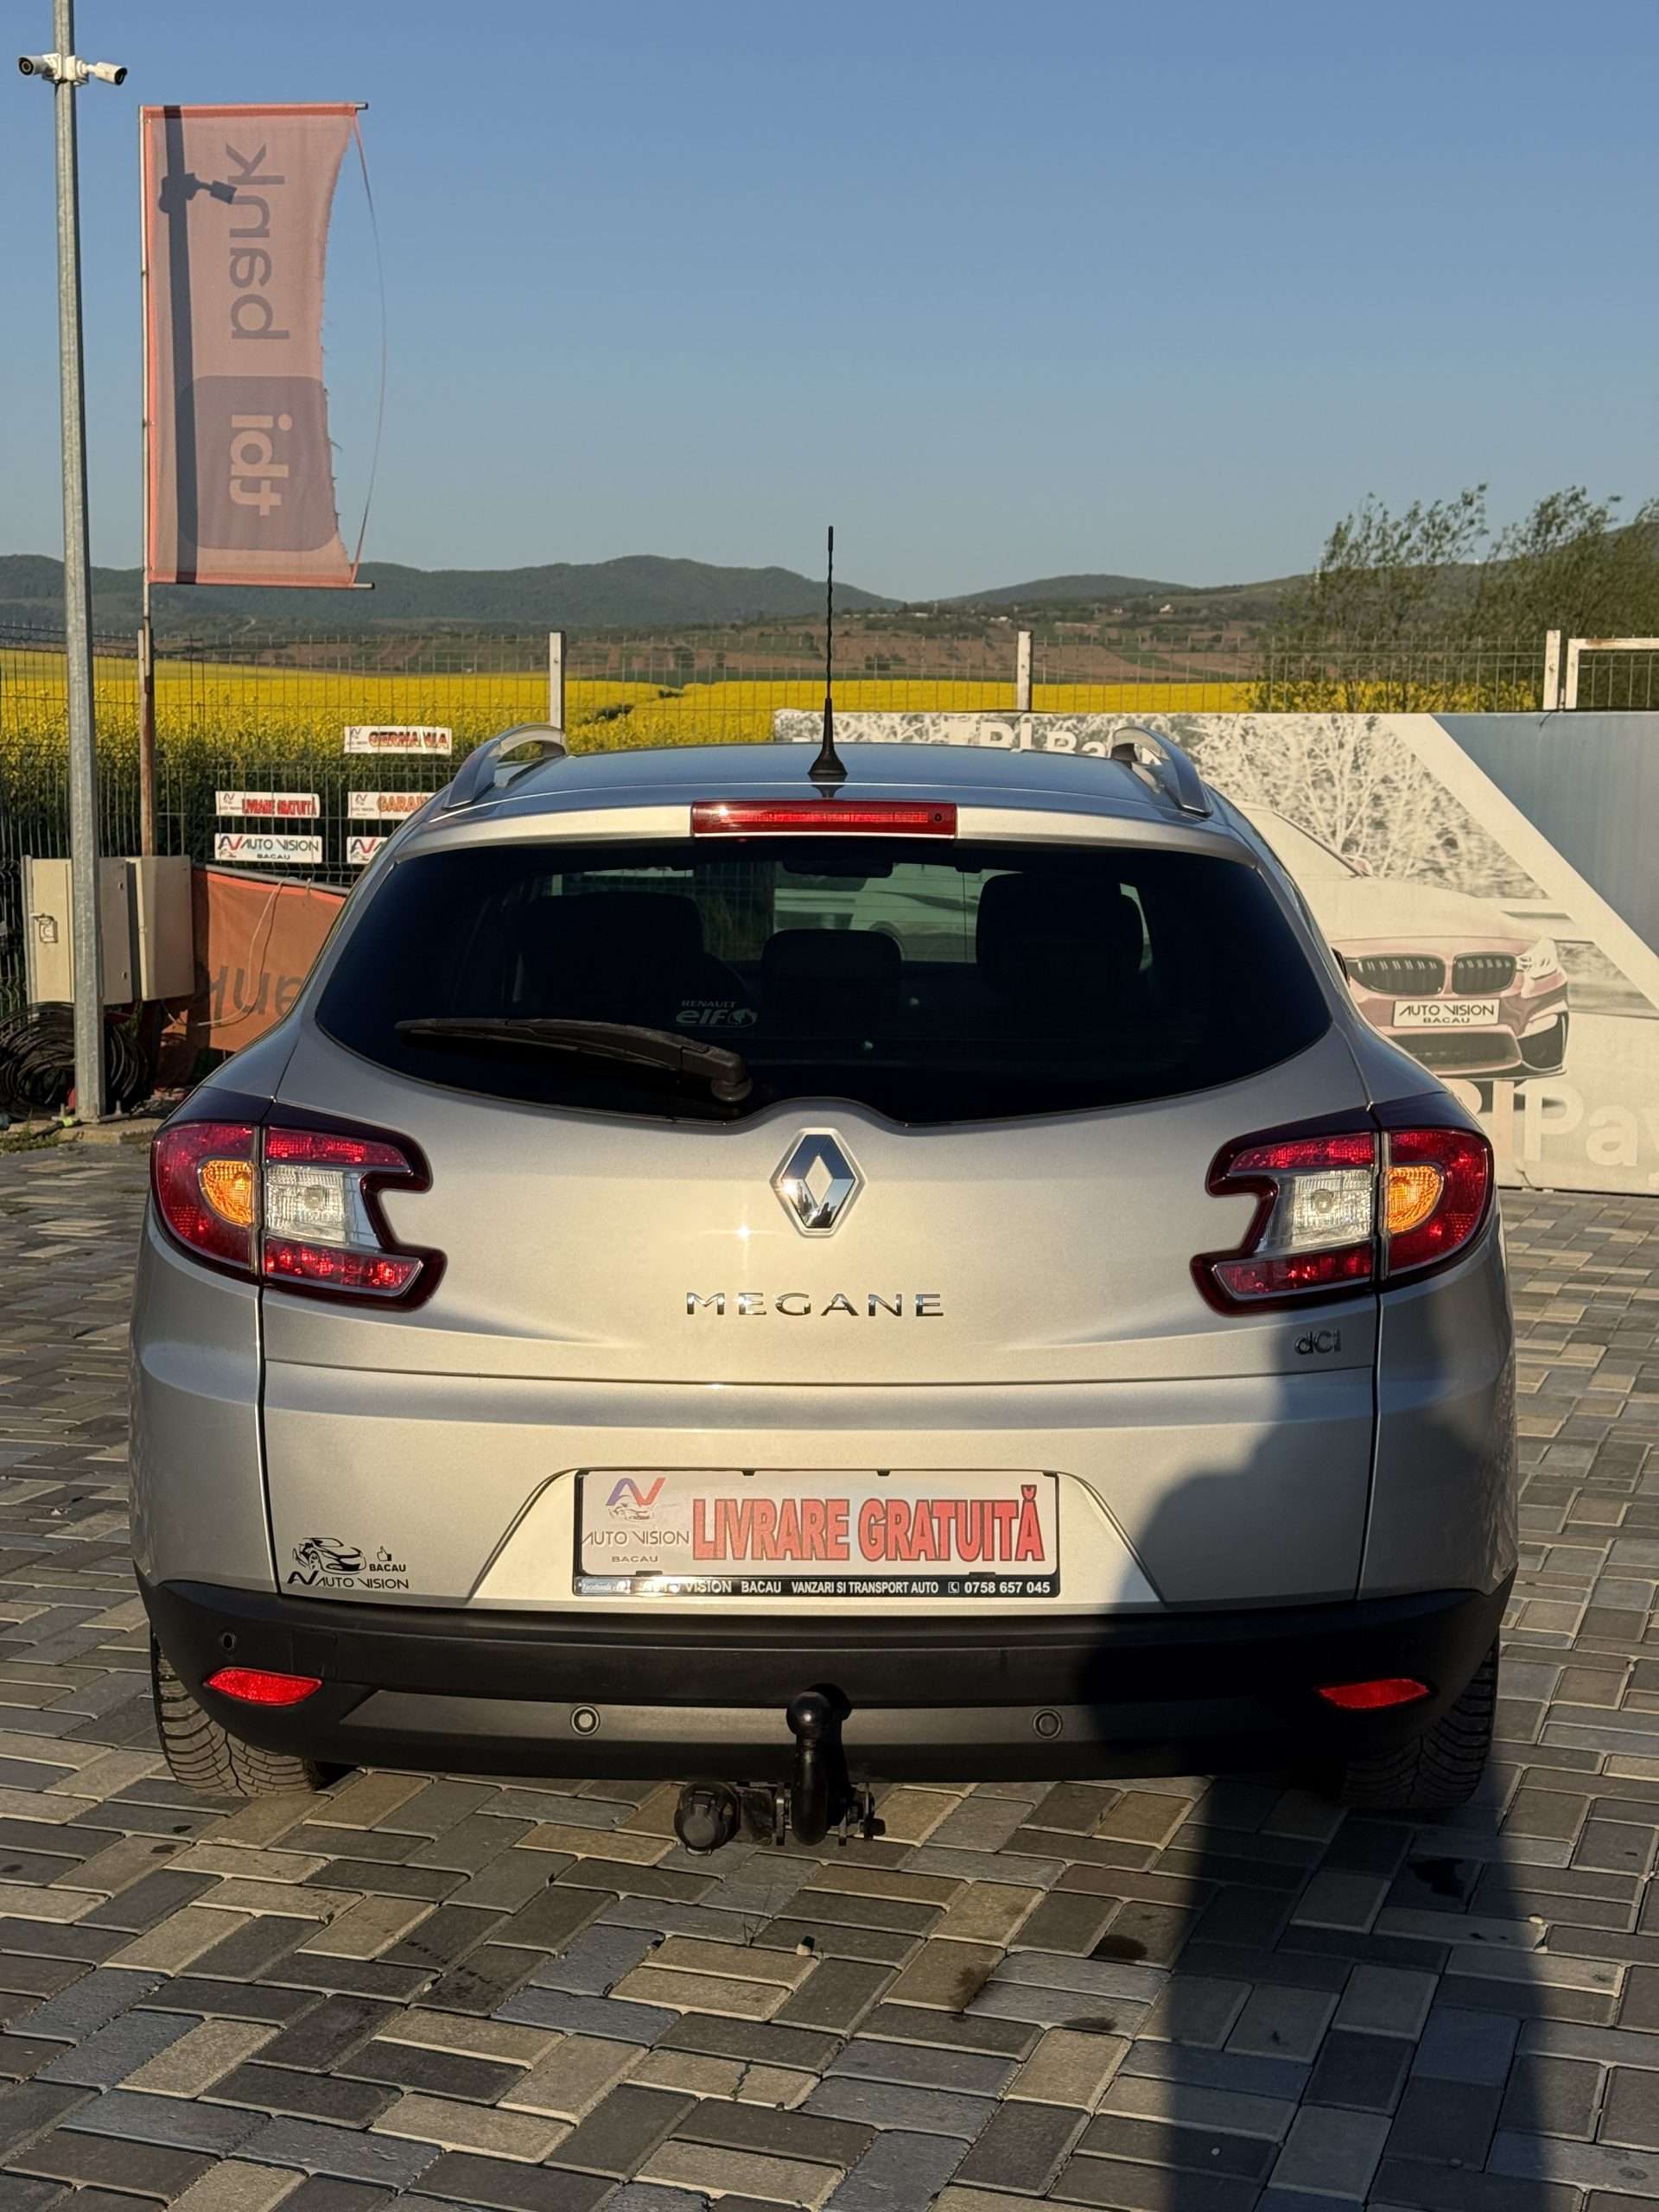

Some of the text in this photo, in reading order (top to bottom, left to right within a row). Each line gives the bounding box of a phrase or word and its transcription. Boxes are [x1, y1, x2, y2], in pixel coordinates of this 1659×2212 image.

[240, 837, 274, 850] AUTO
[276, 838, 319, 852] VISION
[680, 1000, 736, 1008] RENAULT
[1399, 1004, 1495, 1016] AUTO VISION
[676, 1009, 729, 1025] elf
[686, 1292, 944, 1317] MEGANE
[692, 1484, 1046, 1562] LIVRARE GRATUITĂ
[582, 1530, 690, 1545] AUTO VISION
[369, 1563, 406, 1573] BACAU
[315, 1576, 354, 1588] AUTO
[357, 1577, 410, 1590] VISION
[685, 1580, 733, 1593] VISION
[741, 1580, 782, 1593] BACAU
[791, 1581, 834, 1593] VANZARI
[836, 1581, 846, 1593] SI
[848, 1581, 909, 1593] TRANSPORT
[911, 1581, 939, 1593] AUTO
[964, 1581, 995, 1593] 0758
[999, 1581, 1023, 1593] 657
[1027, 1581, 1051, 1593] 045
